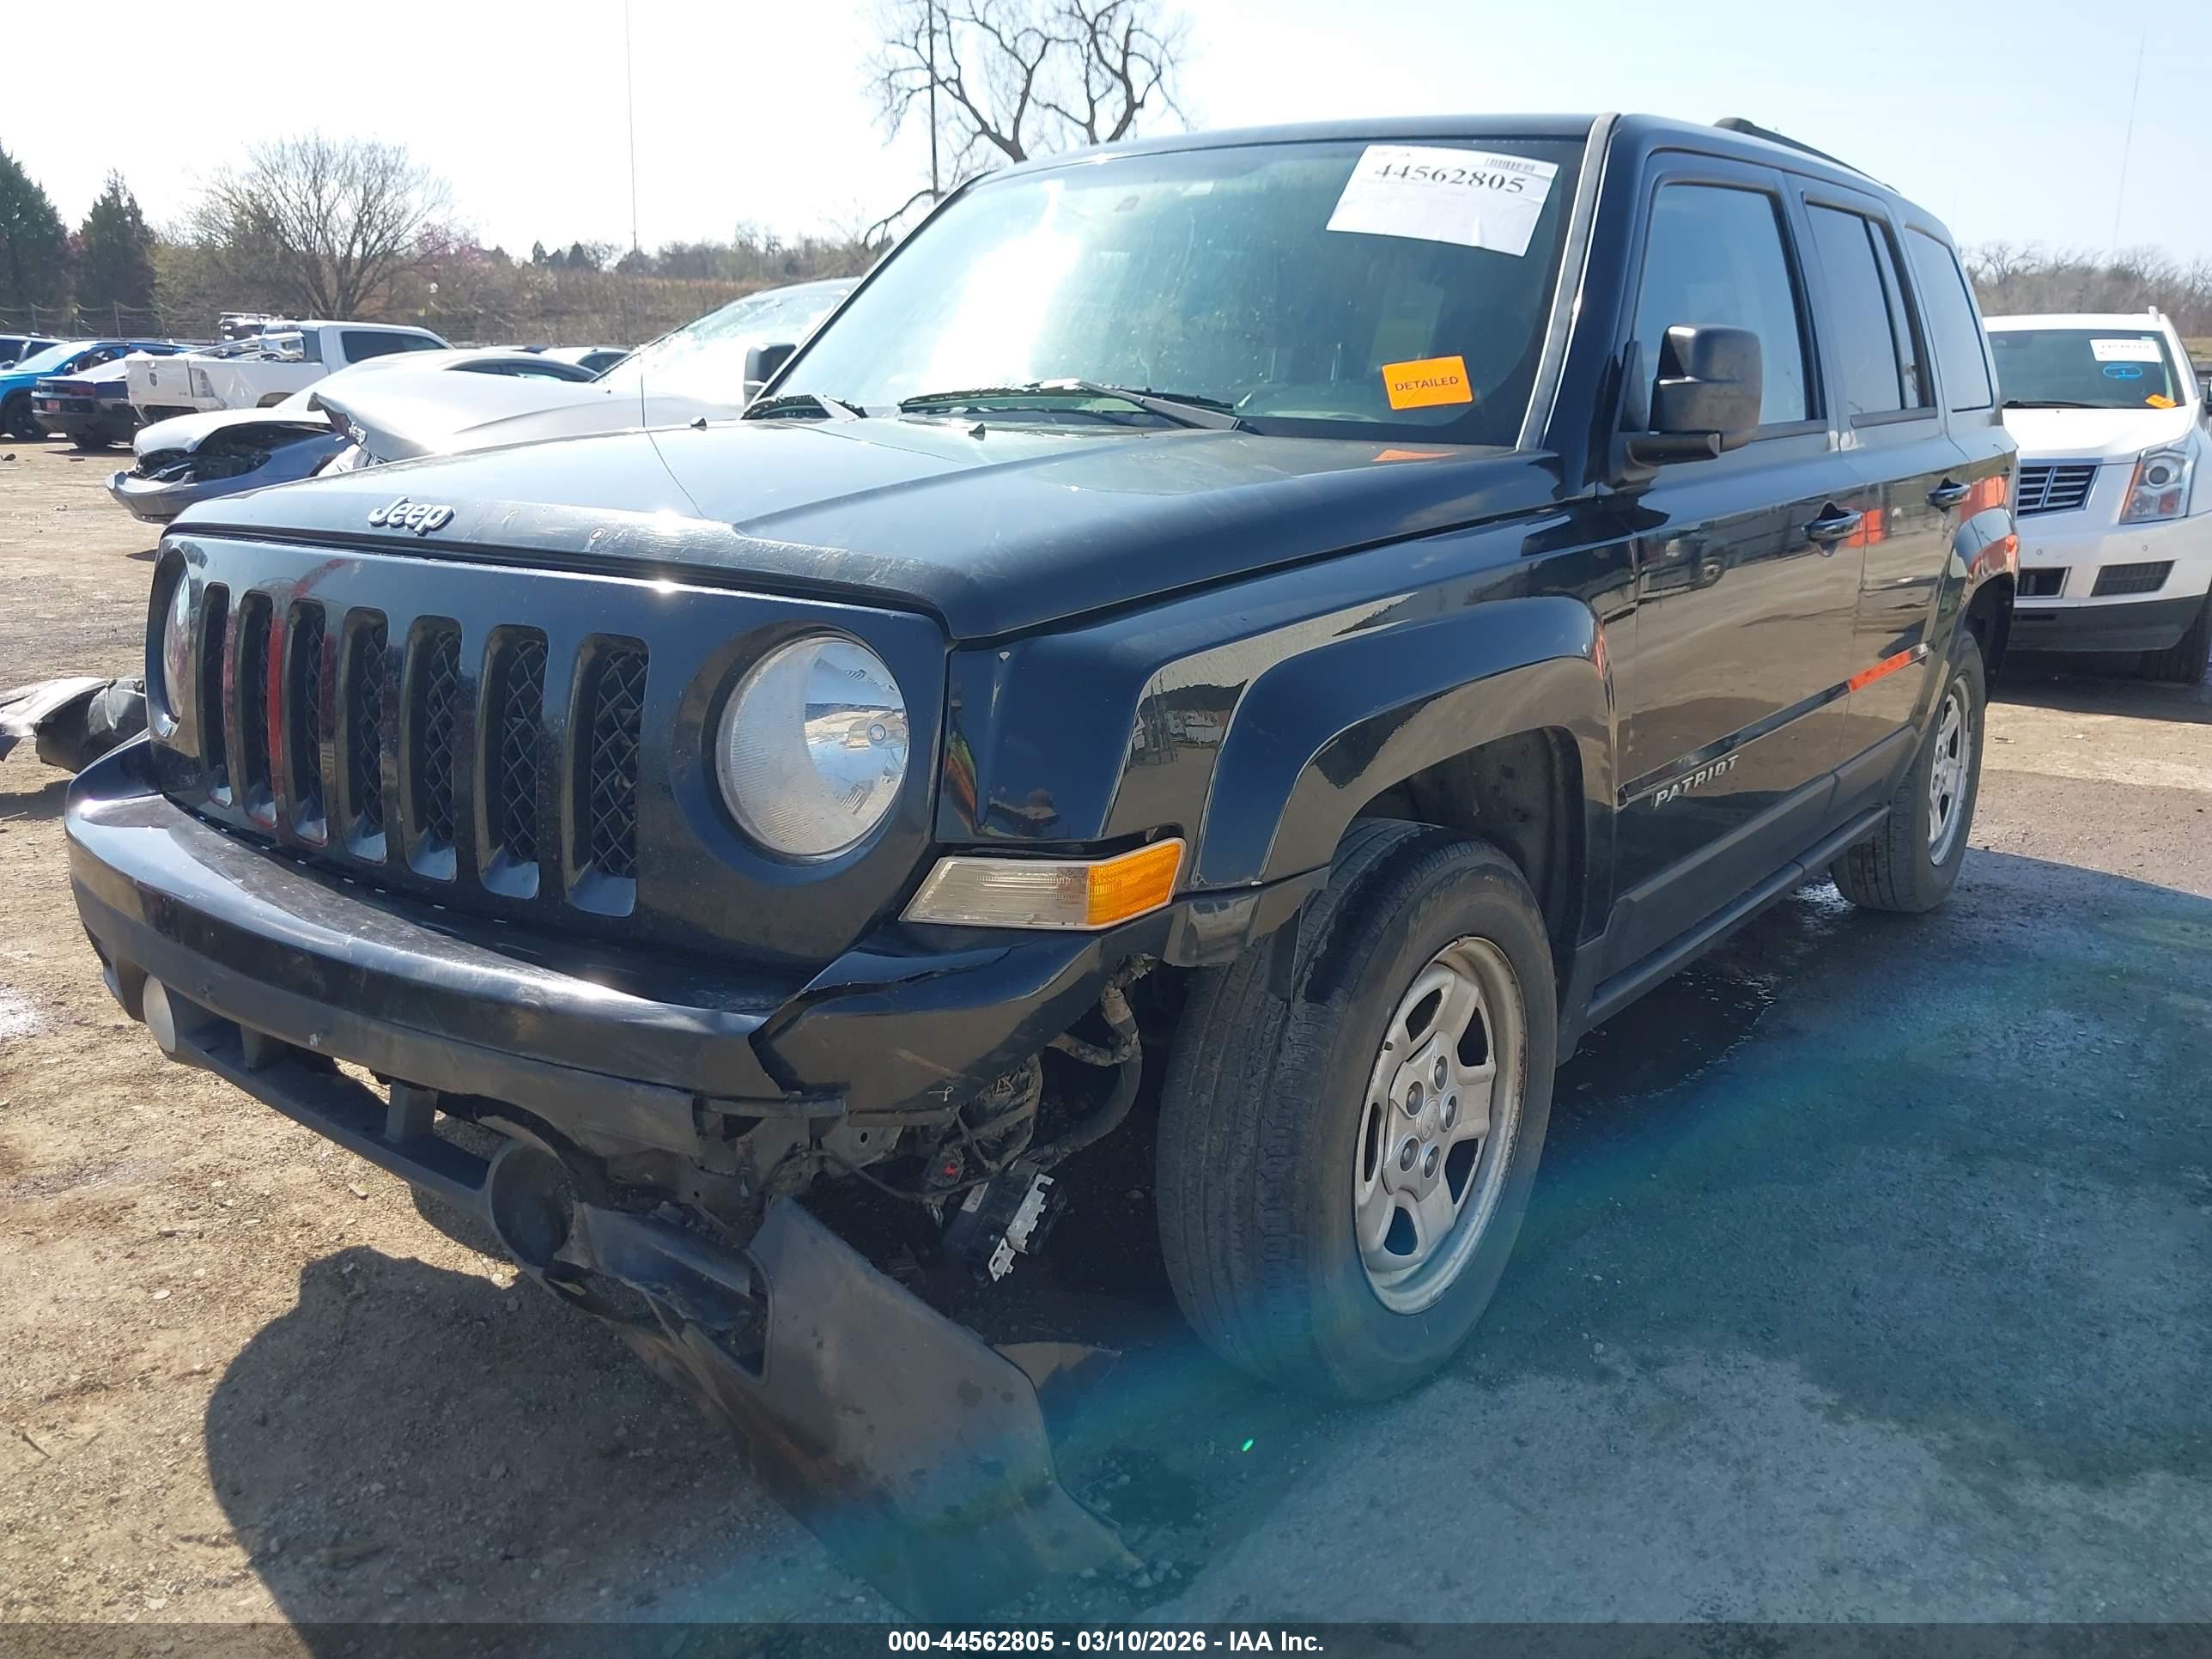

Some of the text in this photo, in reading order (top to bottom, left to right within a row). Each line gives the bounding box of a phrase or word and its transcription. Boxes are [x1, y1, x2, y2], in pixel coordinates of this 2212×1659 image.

[1375, 163, 1526, 194] 44562805
[1395, 376, 1459, 392] DETAILED
[368, 495, 455, 537] Jeep
[1653, 755, 1739, 808] PATRIOT
